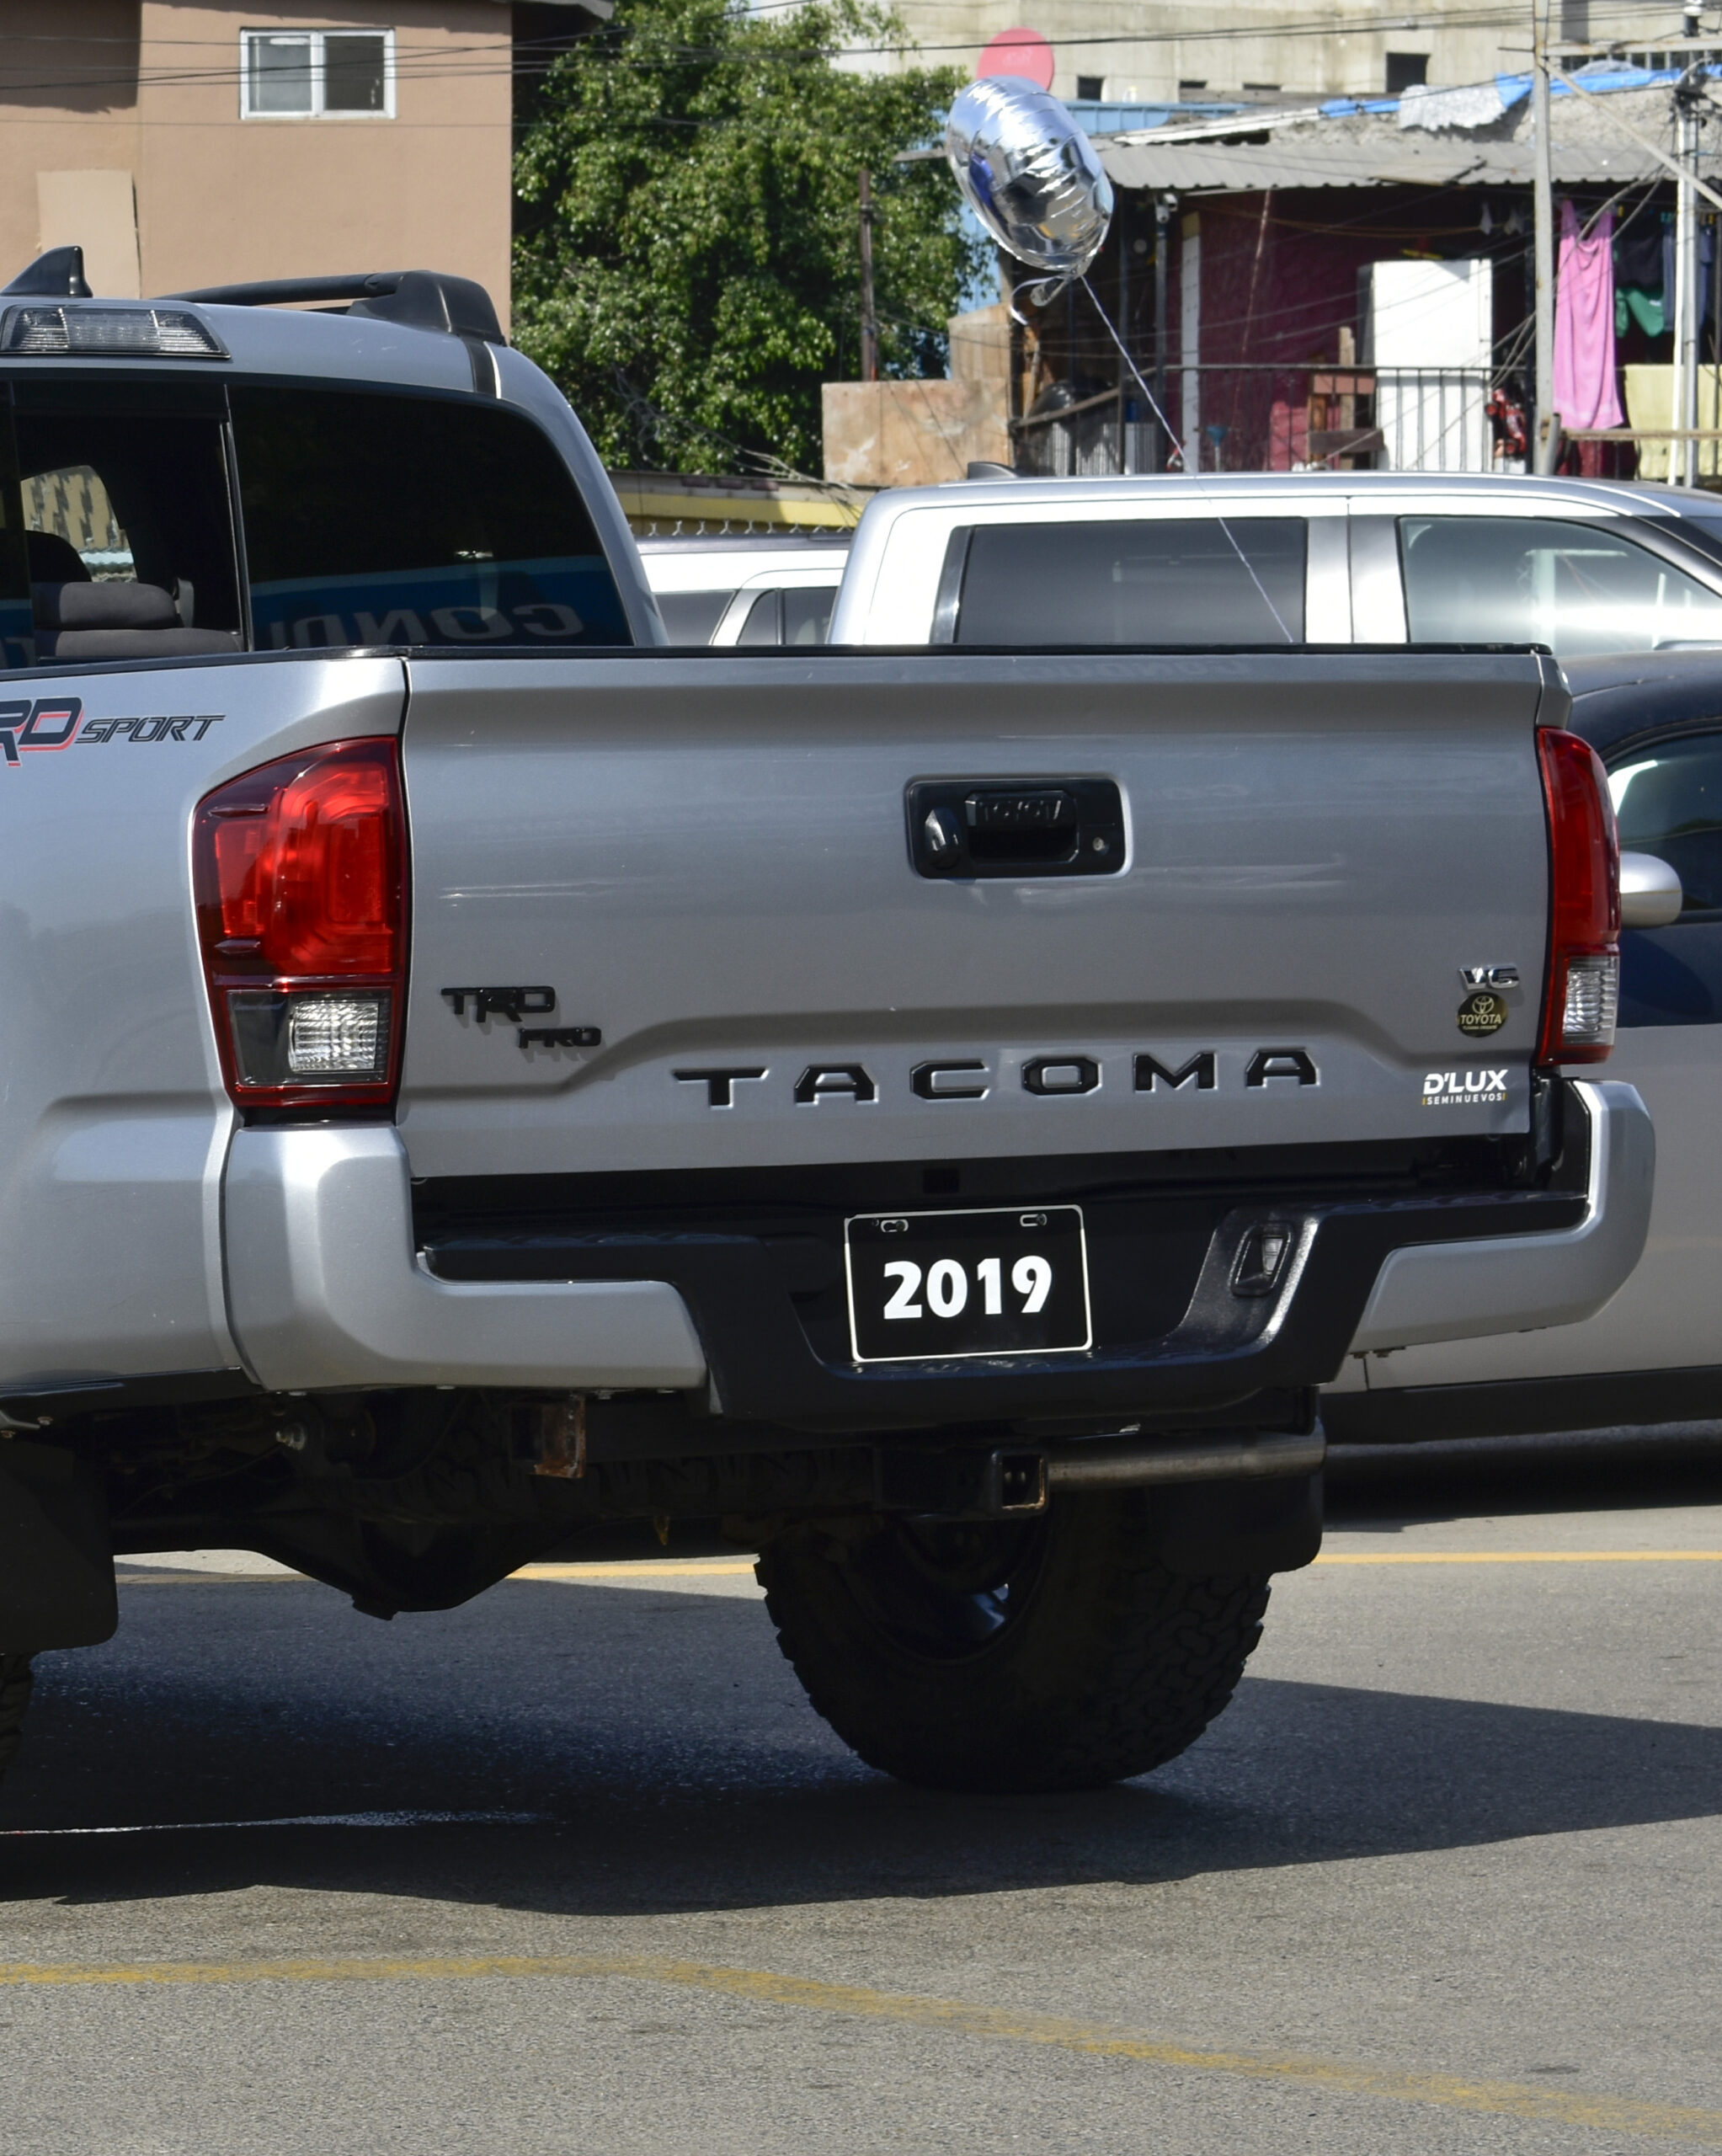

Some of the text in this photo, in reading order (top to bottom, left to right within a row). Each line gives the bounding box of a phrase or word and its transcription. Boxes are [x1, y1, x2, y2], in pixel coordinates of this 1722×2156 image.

[74, 714, 226, 744] SPORT
[440, 985, 556, 1022] TRD
[1460, 1013, 1502, 1025] TOYOTA
[518, 1027, 602, 1049] PRO
[672, 1048, 1320, 1109] TACOMA
[1423, 1069, 1508, 1095] D'LUX
[1426, 1092, 1502, 1106] SEMINUEVOS
[883, 1256, 1052, 1320] 2019
